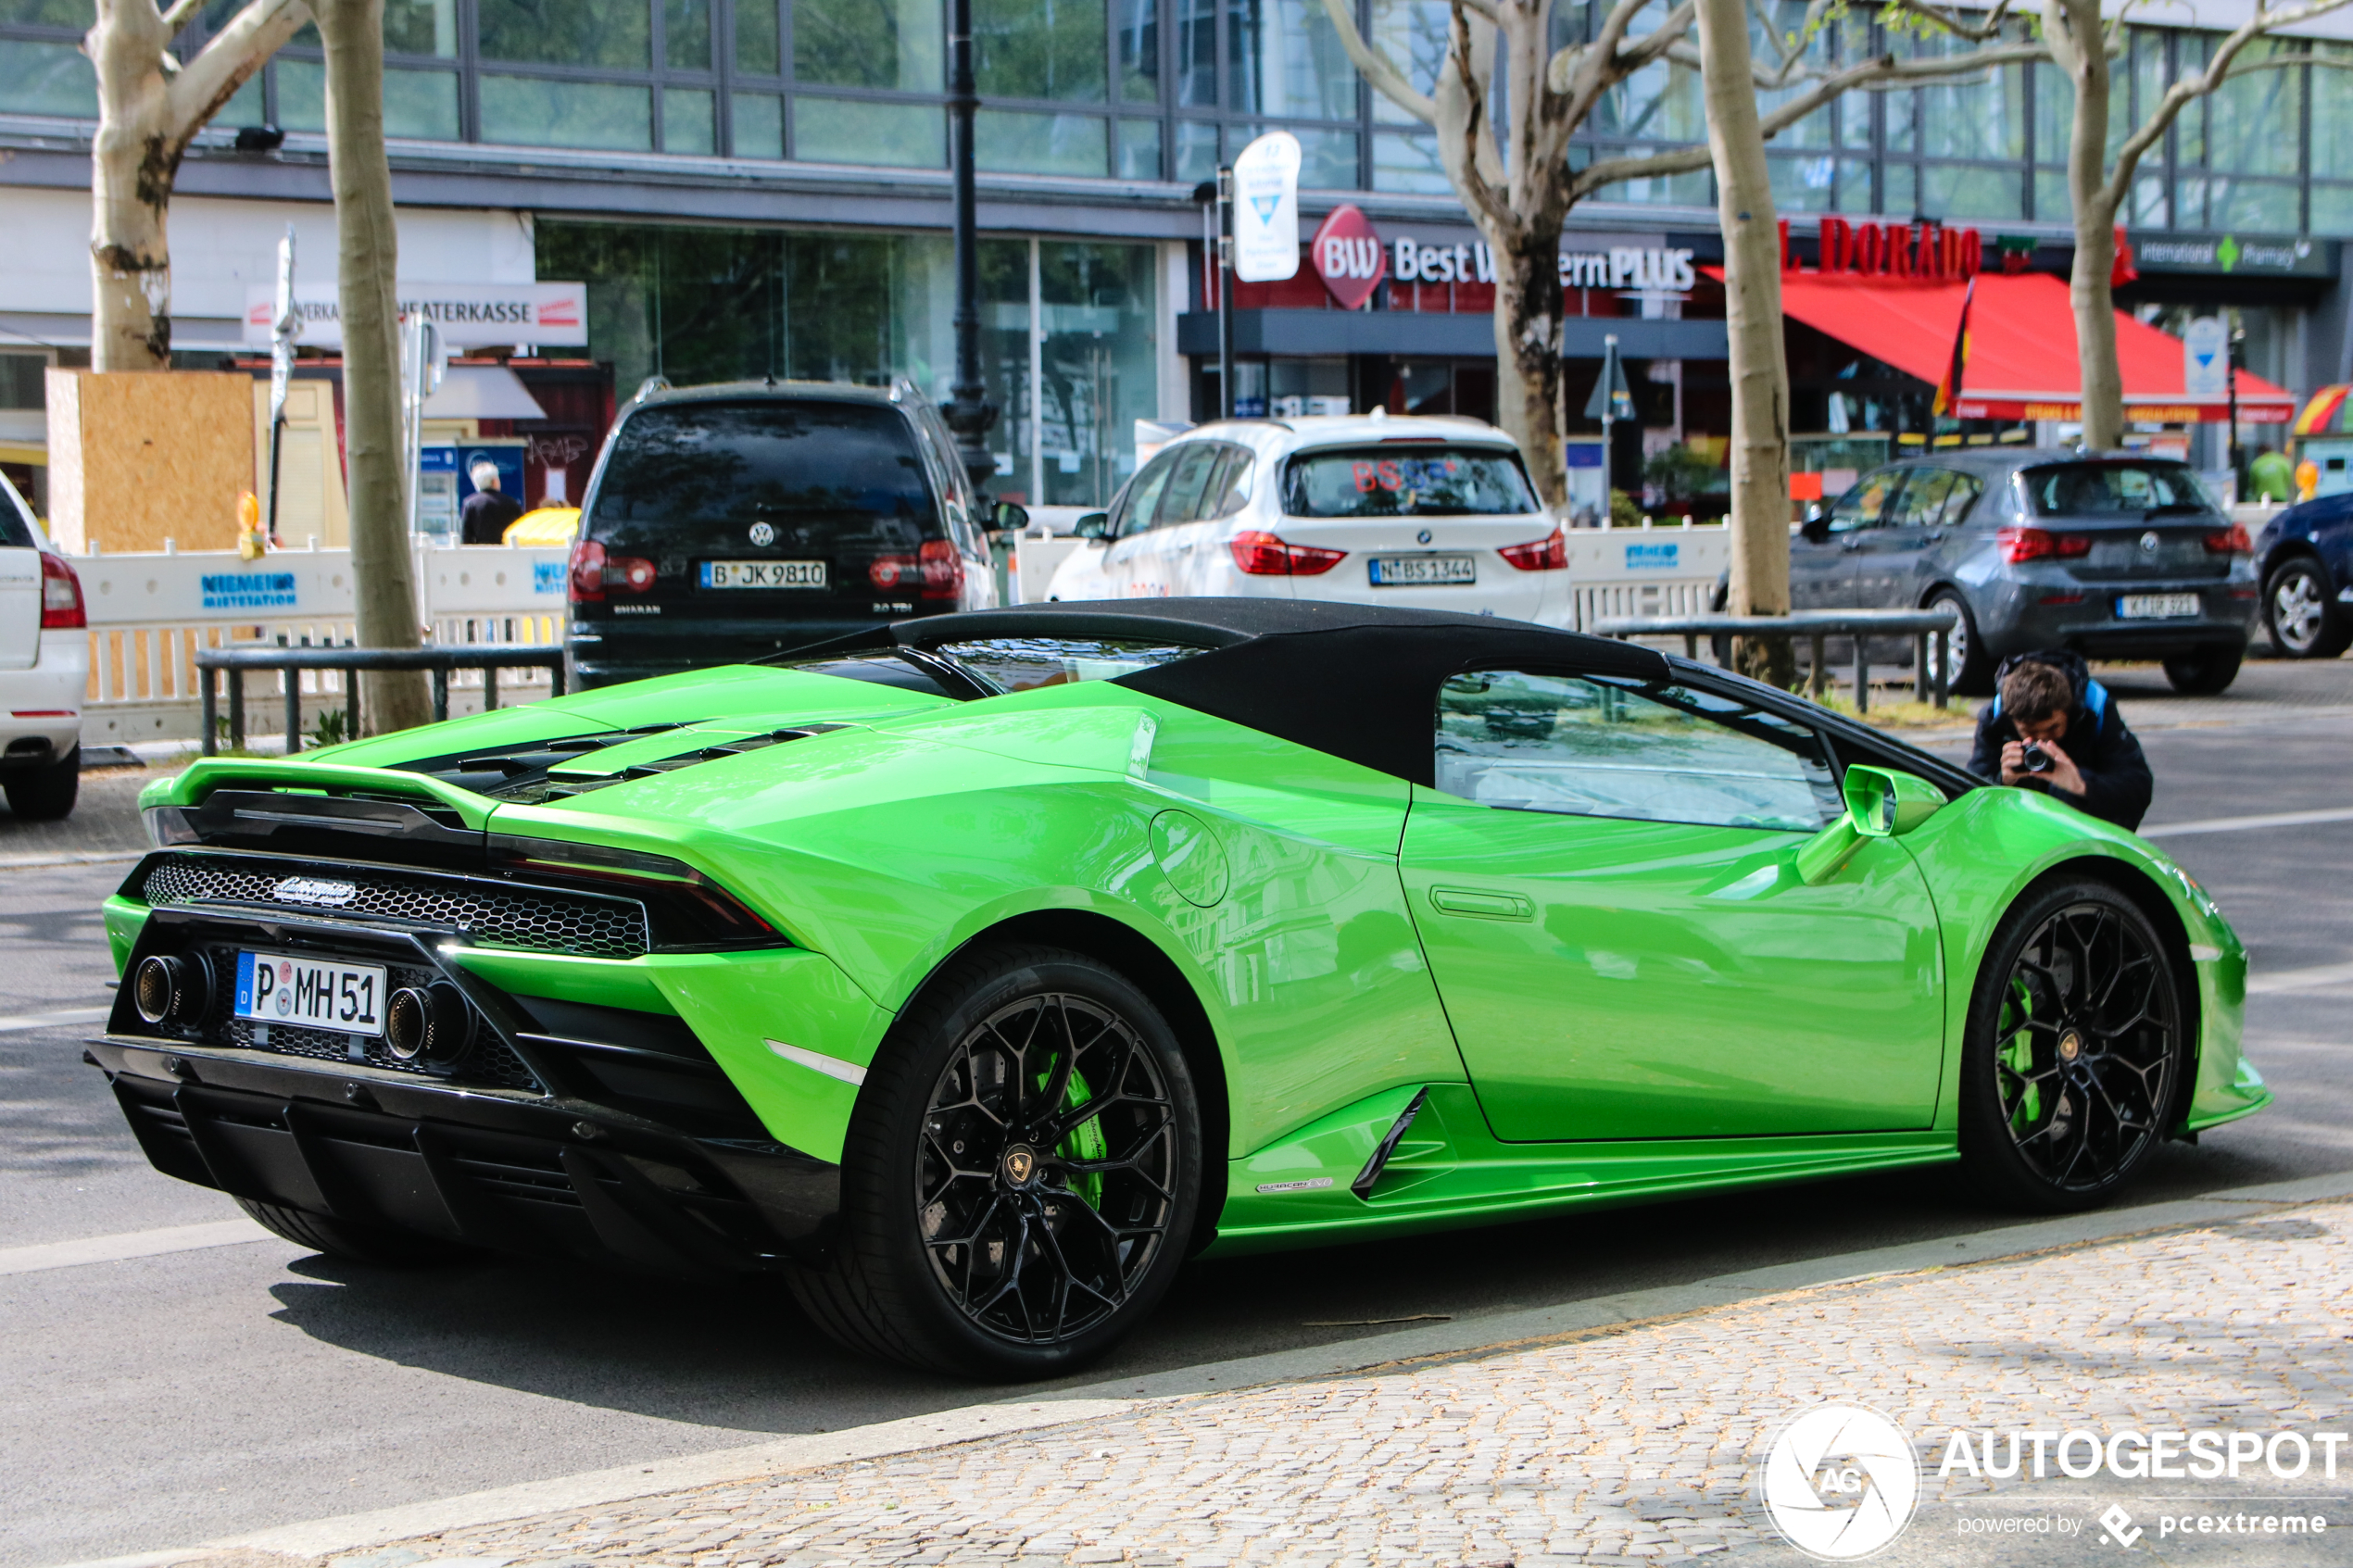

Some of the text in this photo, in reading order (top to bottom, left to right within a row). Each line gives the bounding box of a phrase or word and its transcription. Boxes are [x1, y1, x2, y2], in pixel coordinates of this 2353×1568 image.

[1324, 236, 1378, 279] BW
[1396, 237, 1471, 282] Best
[1819, 217, 1982, 277] DORADO
[715, 566, 728, 583] B
[773, 564, 823, 584] 9810
[257, 963, 274, 1010] P
